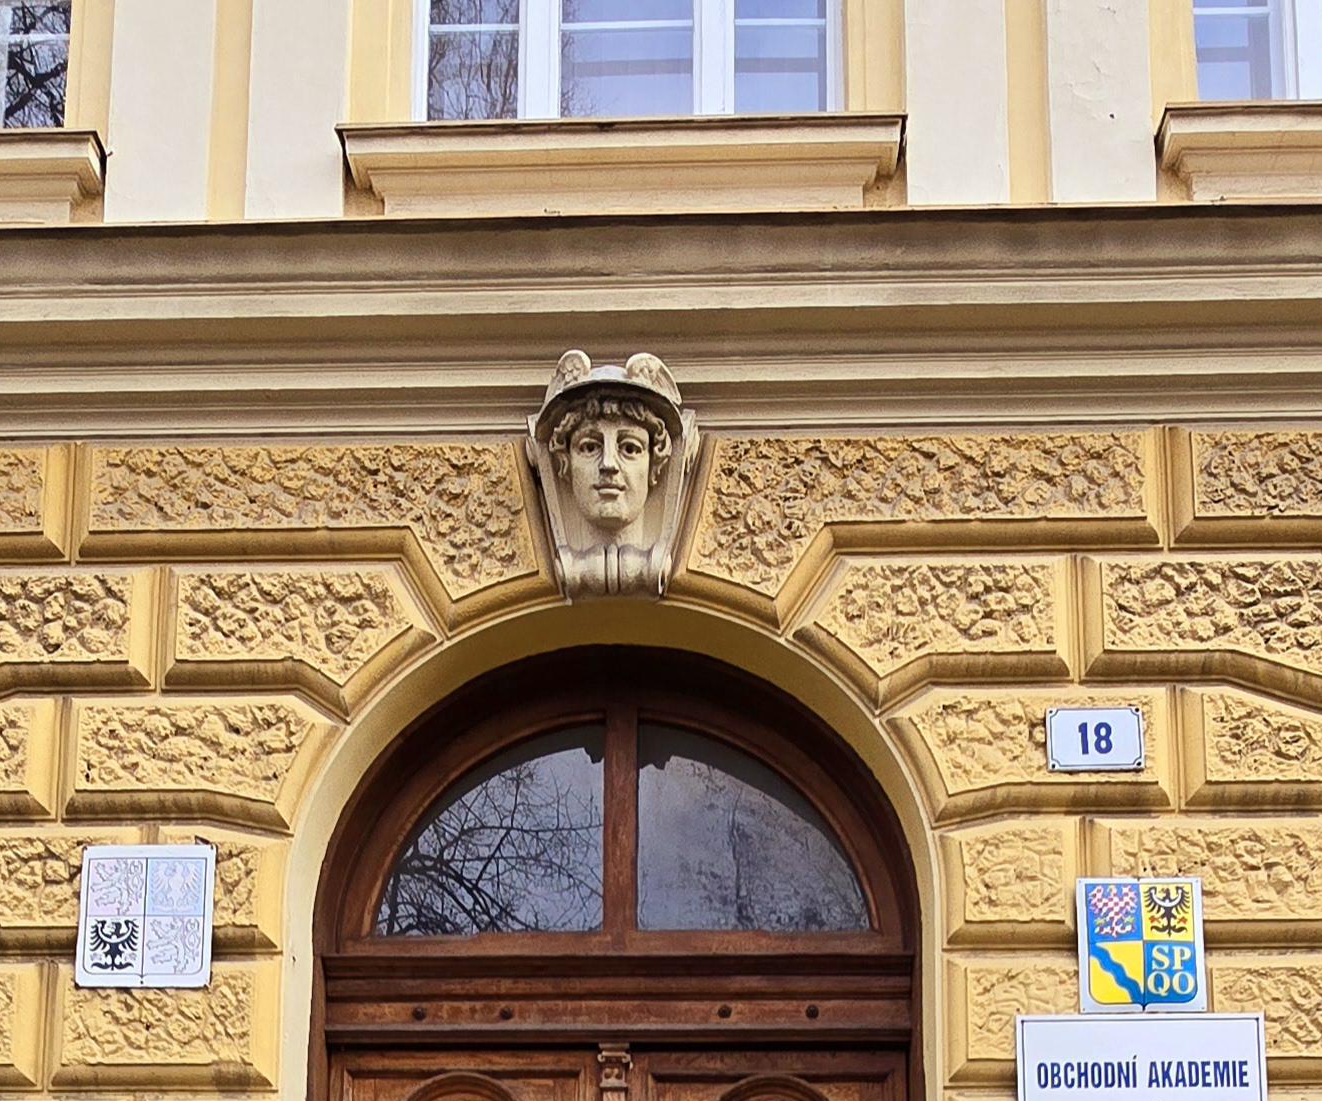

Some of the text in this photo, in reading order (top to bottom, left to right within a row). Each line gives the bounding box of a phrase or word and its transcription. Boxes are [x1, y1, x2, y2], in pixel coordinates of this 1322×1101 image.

[1078, 721, 1113, 755] 18
[1151, 944, 1192, 970] SP
[1147, 970, 1195, 996] QO
[1036, 1054, 1250, 1089] OBCHODNÍ AKADEMIE
